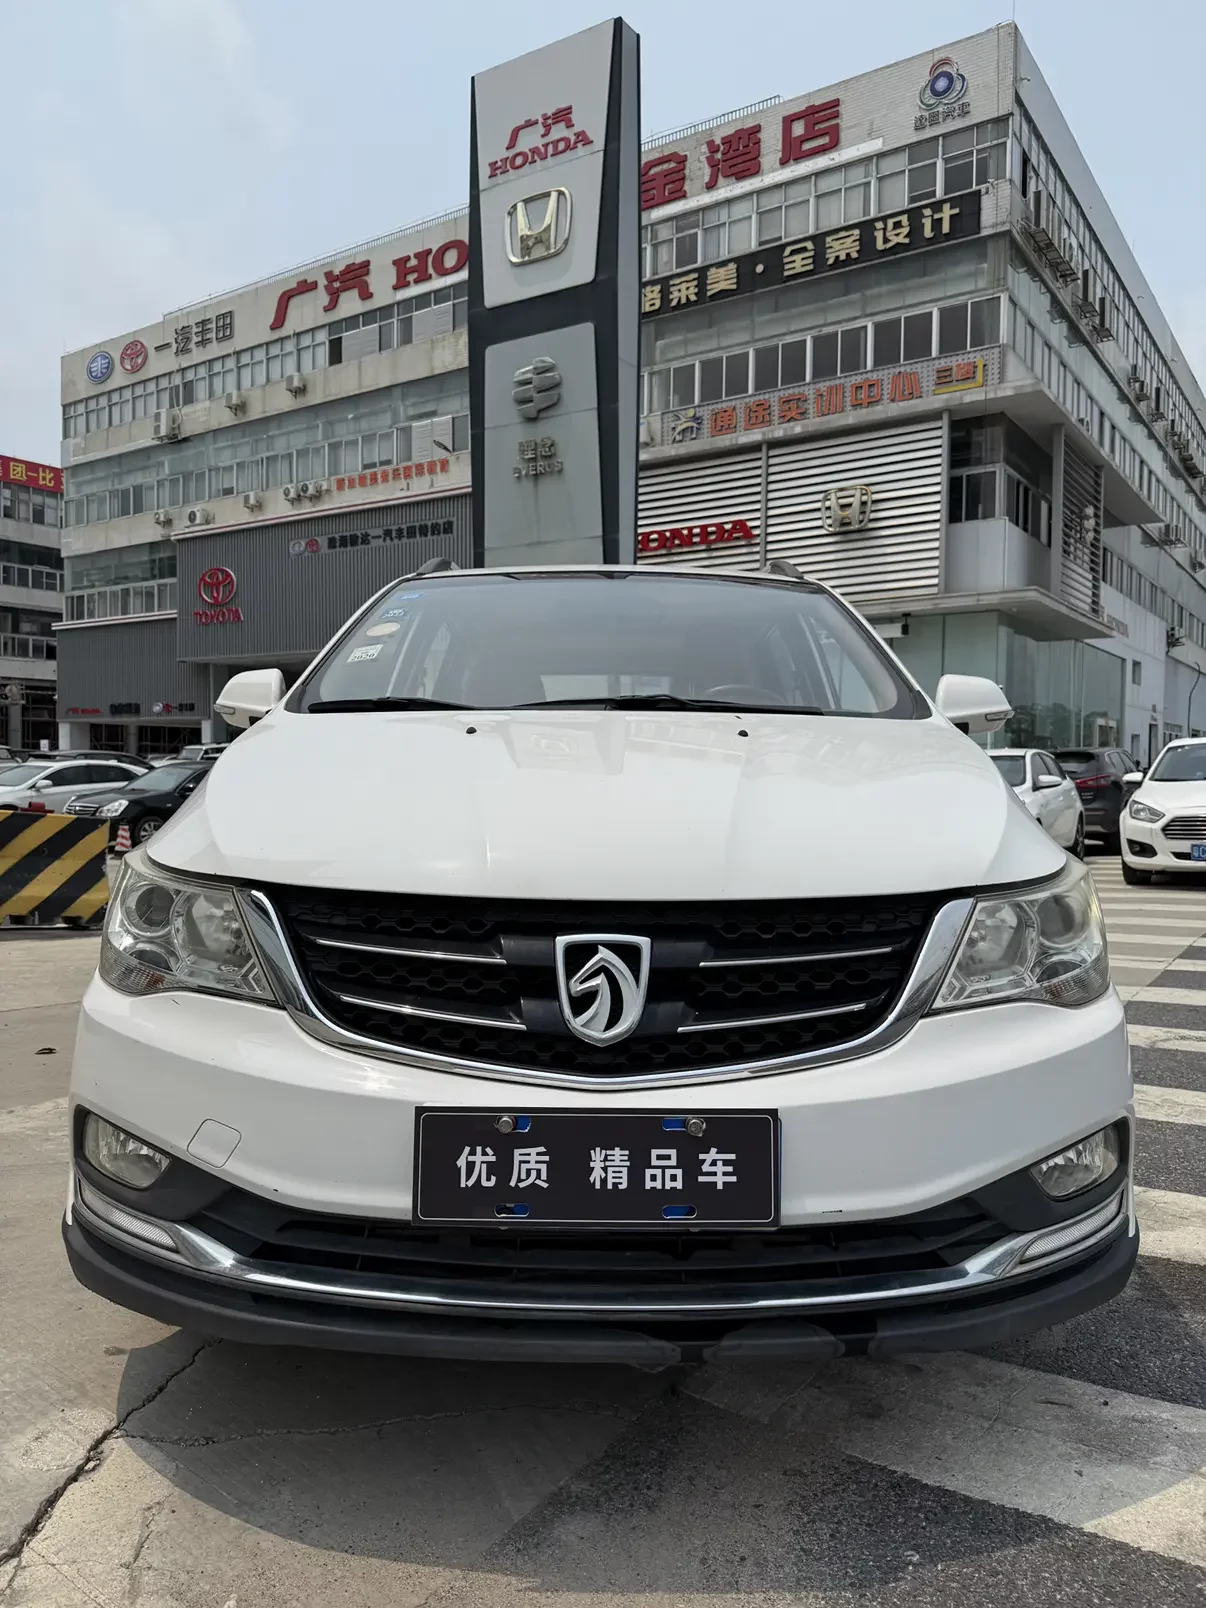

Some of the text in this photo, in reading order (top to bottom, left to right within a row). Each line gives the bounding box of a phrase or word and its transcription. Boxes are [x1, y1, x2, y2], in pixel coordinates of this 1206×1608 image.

[506, 104, 575, 150] 广汽
[488, 129, 594, 179] HONDA
[641, 97, 840, 211] 金湾店
[269, 239, 469, 331] 广汽 HO
[154, 310, 235, 357] 一汽丰田
[710, 371, 921, 436] 通途实训中心
[638, 519, 757, 552] ONDA
[192, 607, 244, 625] TOYOTA
[455, 1146, 738, 1190] 优质 精品车
